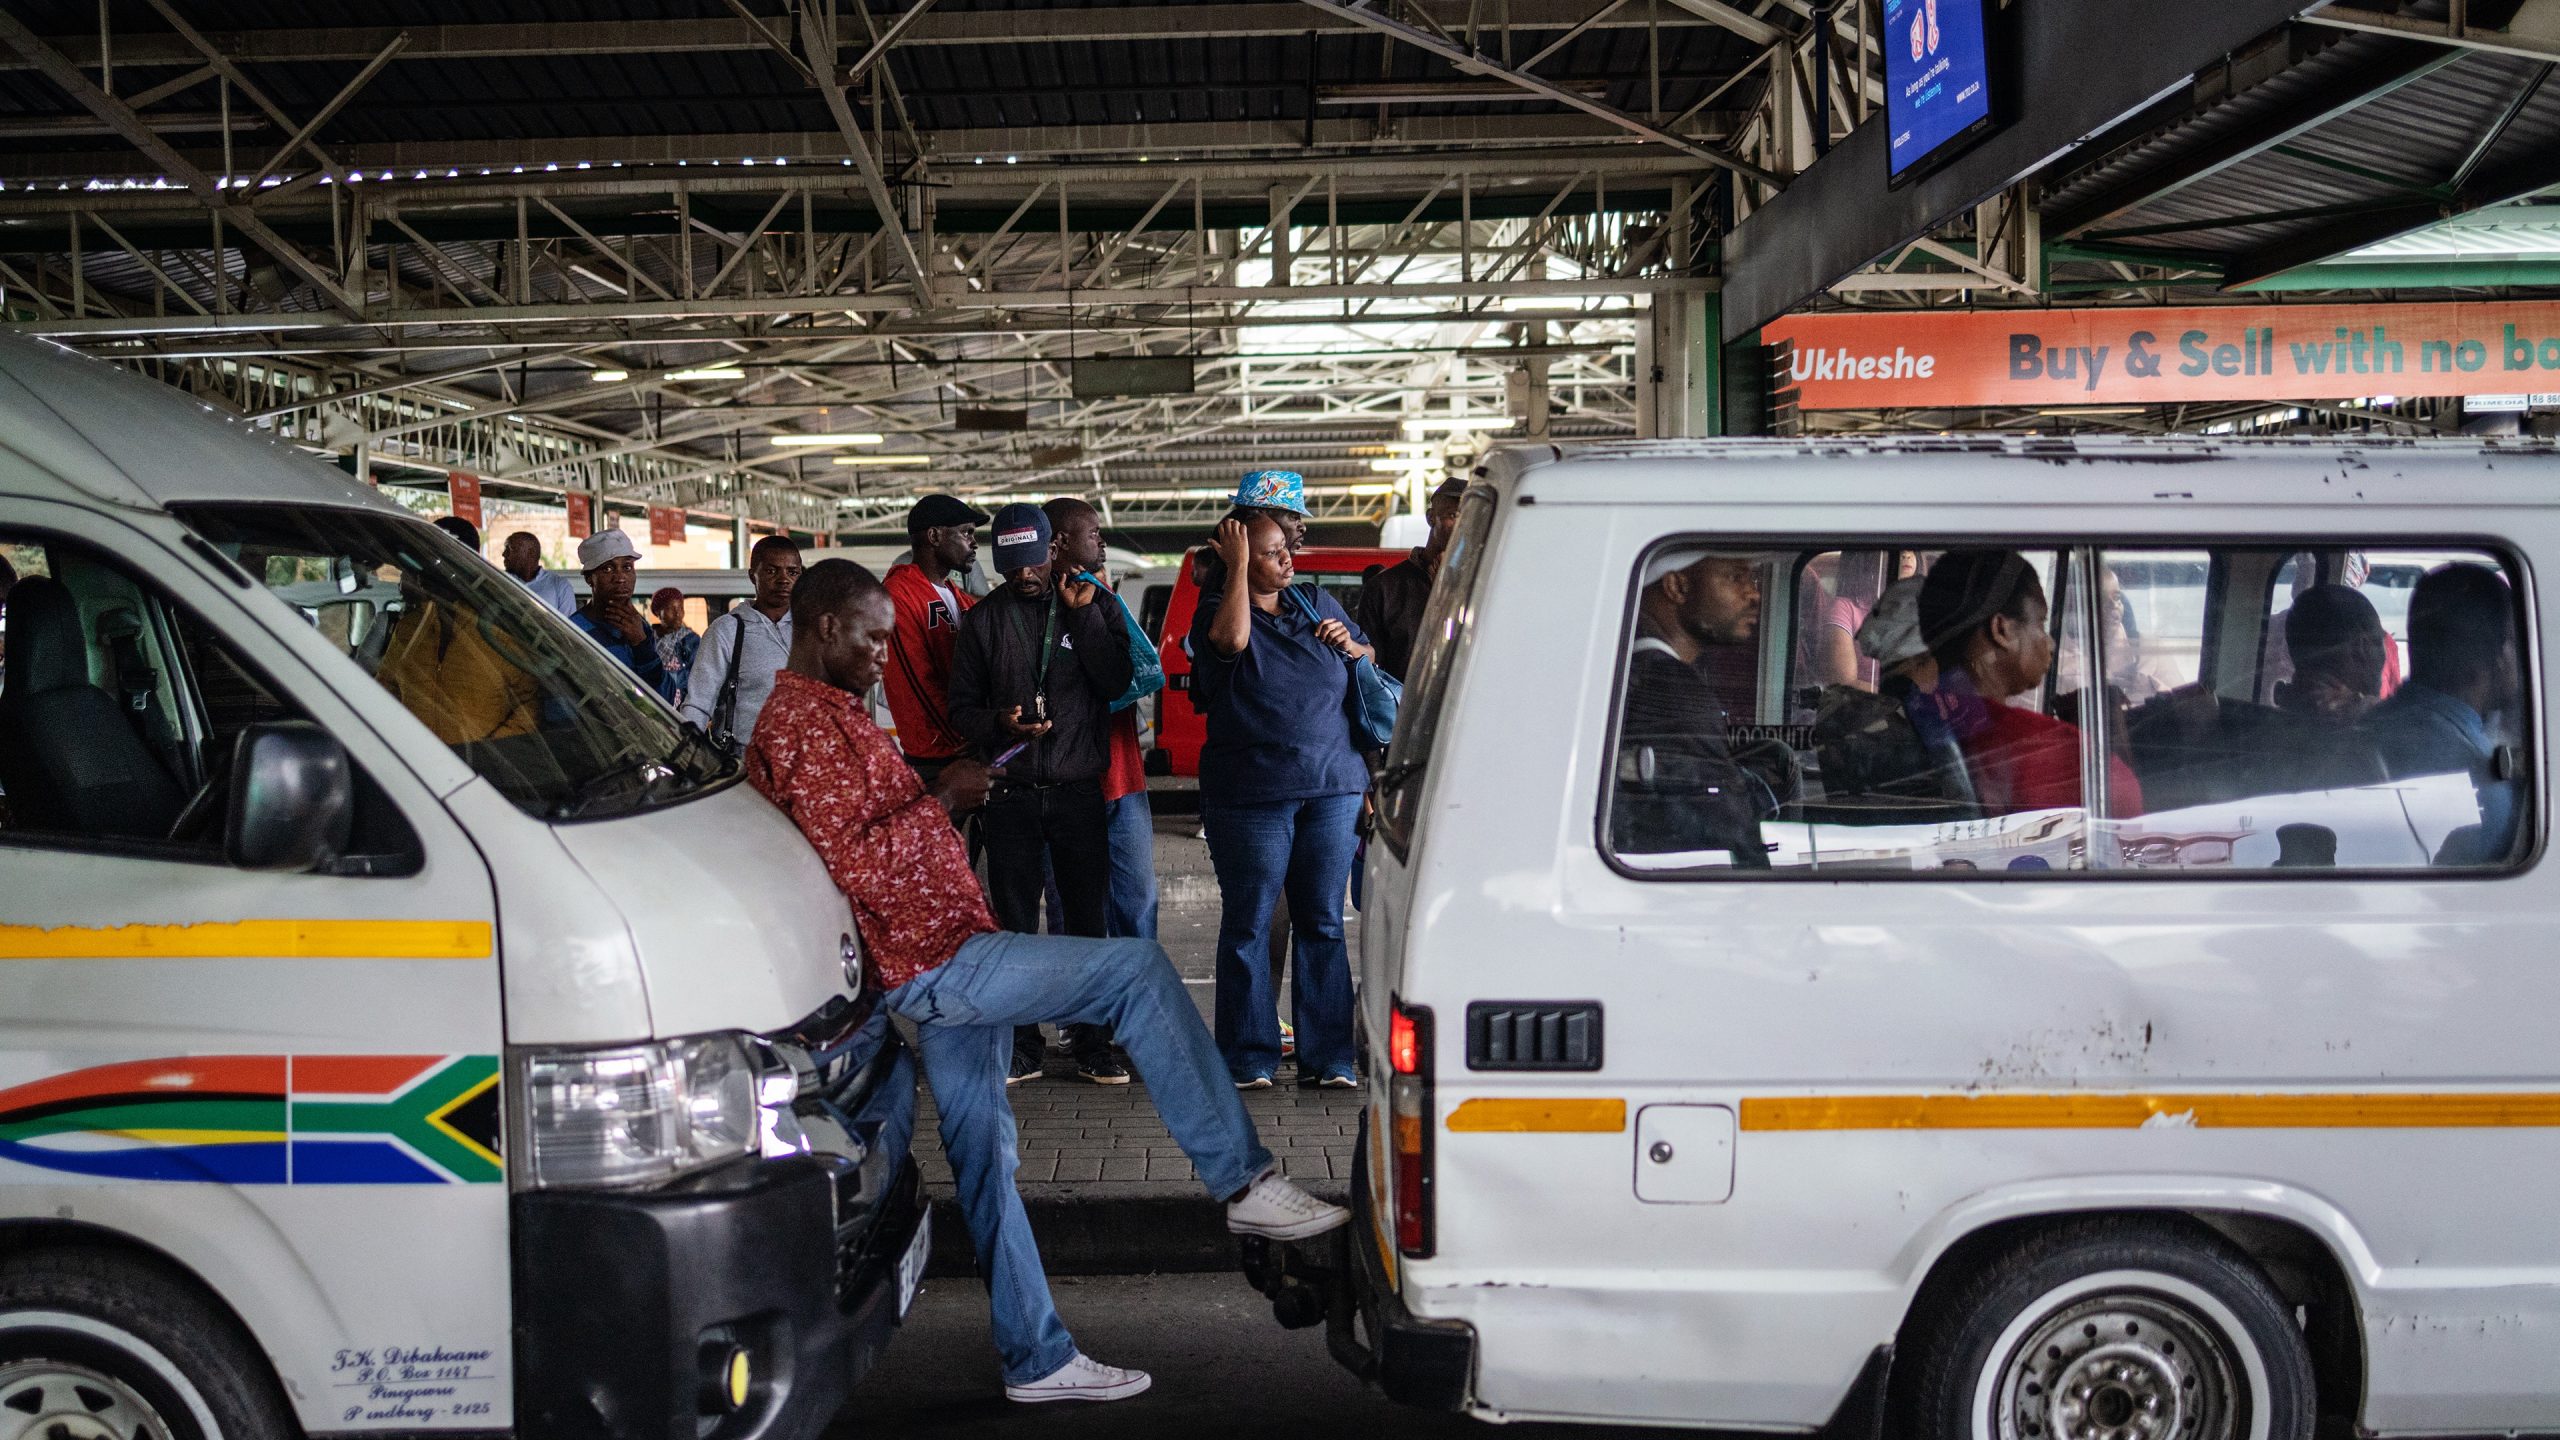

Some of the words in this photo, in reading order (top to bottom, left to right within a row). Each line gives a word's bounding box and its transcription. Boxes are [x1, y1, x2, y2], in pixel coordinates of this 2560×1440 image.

[1791, 347, 1935, 381] Ukheshe
[2009, 333, 2109, 391] Buy
[2125, 331, 2162, 379] &
[2178, 326, 2273, 377] Sell
[2289, 325, 2404, 375] with
[2421, 338, 2487, 373] no
[383, 1345, 493, 1366] Dibakoane
[357, 1366, 391, 1383] P.O.
[400, 1365, 432, 1380] Box
[452, 1401, 490, 1416] 2125
